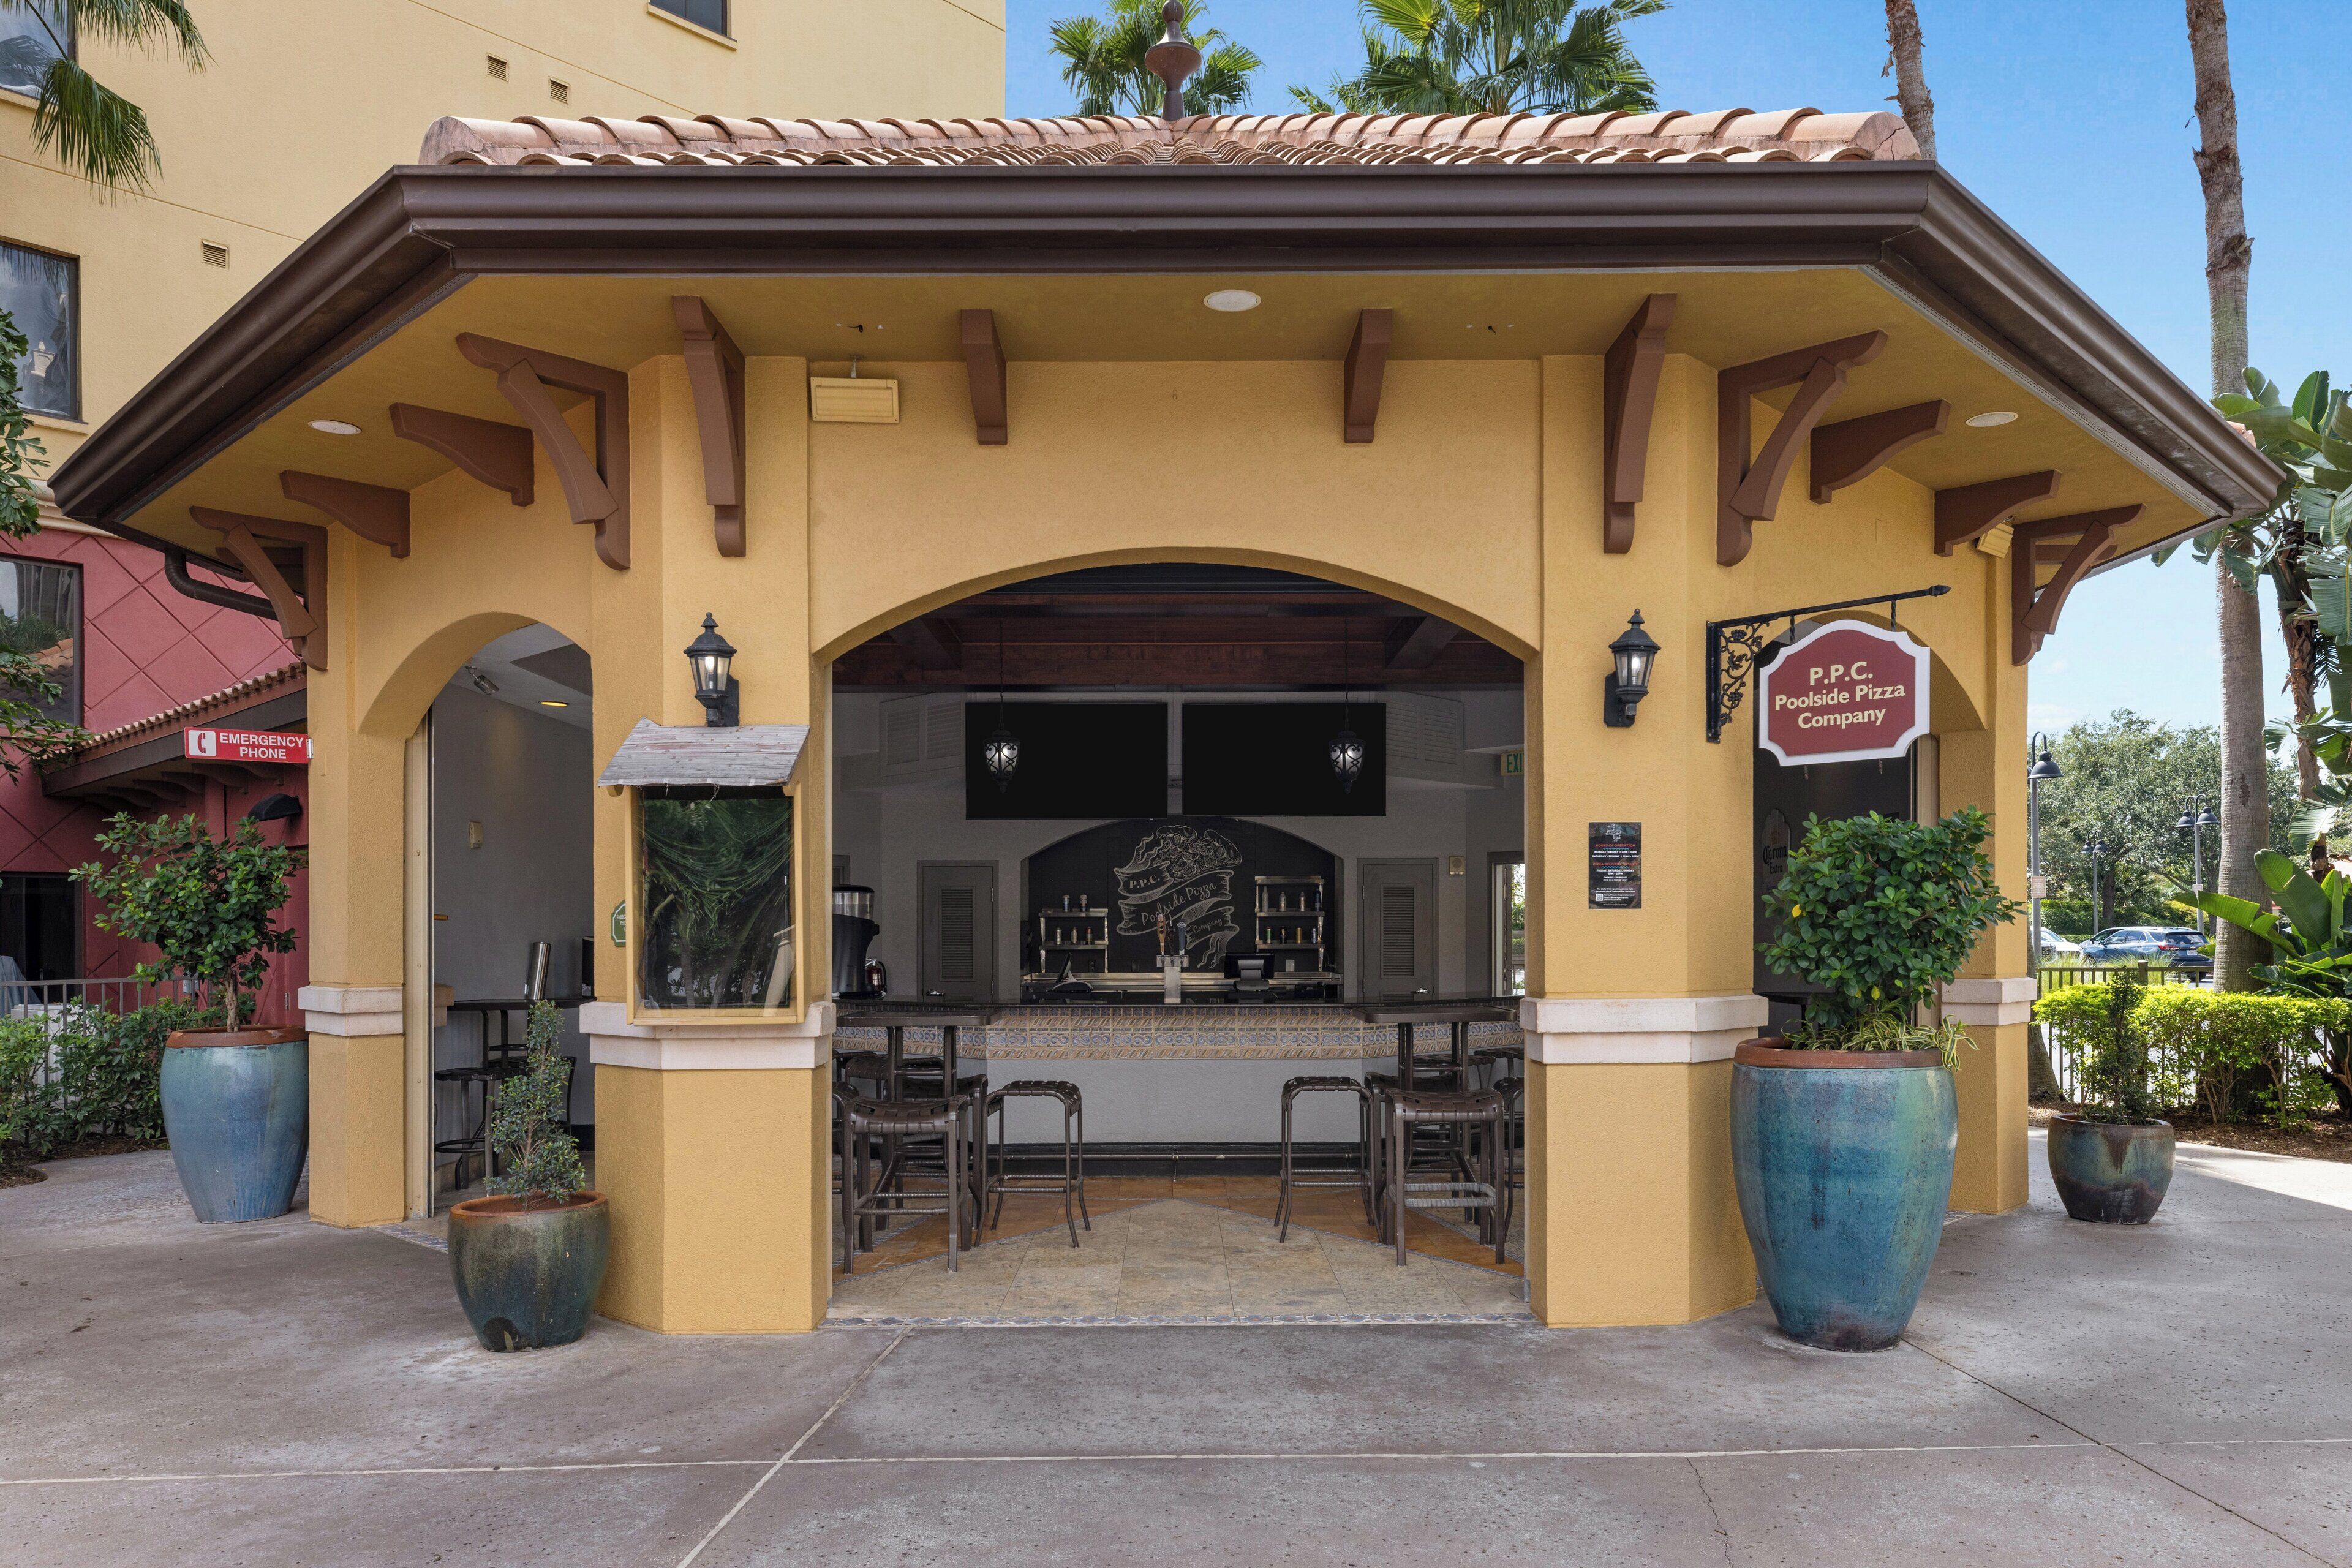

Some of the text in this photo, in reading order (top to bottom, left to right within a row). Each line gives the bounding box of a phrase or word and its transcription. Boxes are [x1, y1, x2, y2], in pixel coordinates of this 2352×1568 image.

[1809, 662, 1873, 685] P.P.C.
[1775, 684, 1905, 710] Poolside Pizza
[1798, 708, 1886, 729] Company
[220, 733, 304, 747] EMERGENCY
[239, 747, 287, 759] PHONE
[1507, 753, 1524, 772] EXI
[1763, 845, 1787, 864] Corona
[1129, 875, 1160, 889] P.P.C.
[1185, 882, 1218, 900] Pizza
[1193, 918, 1223, 933] Company
